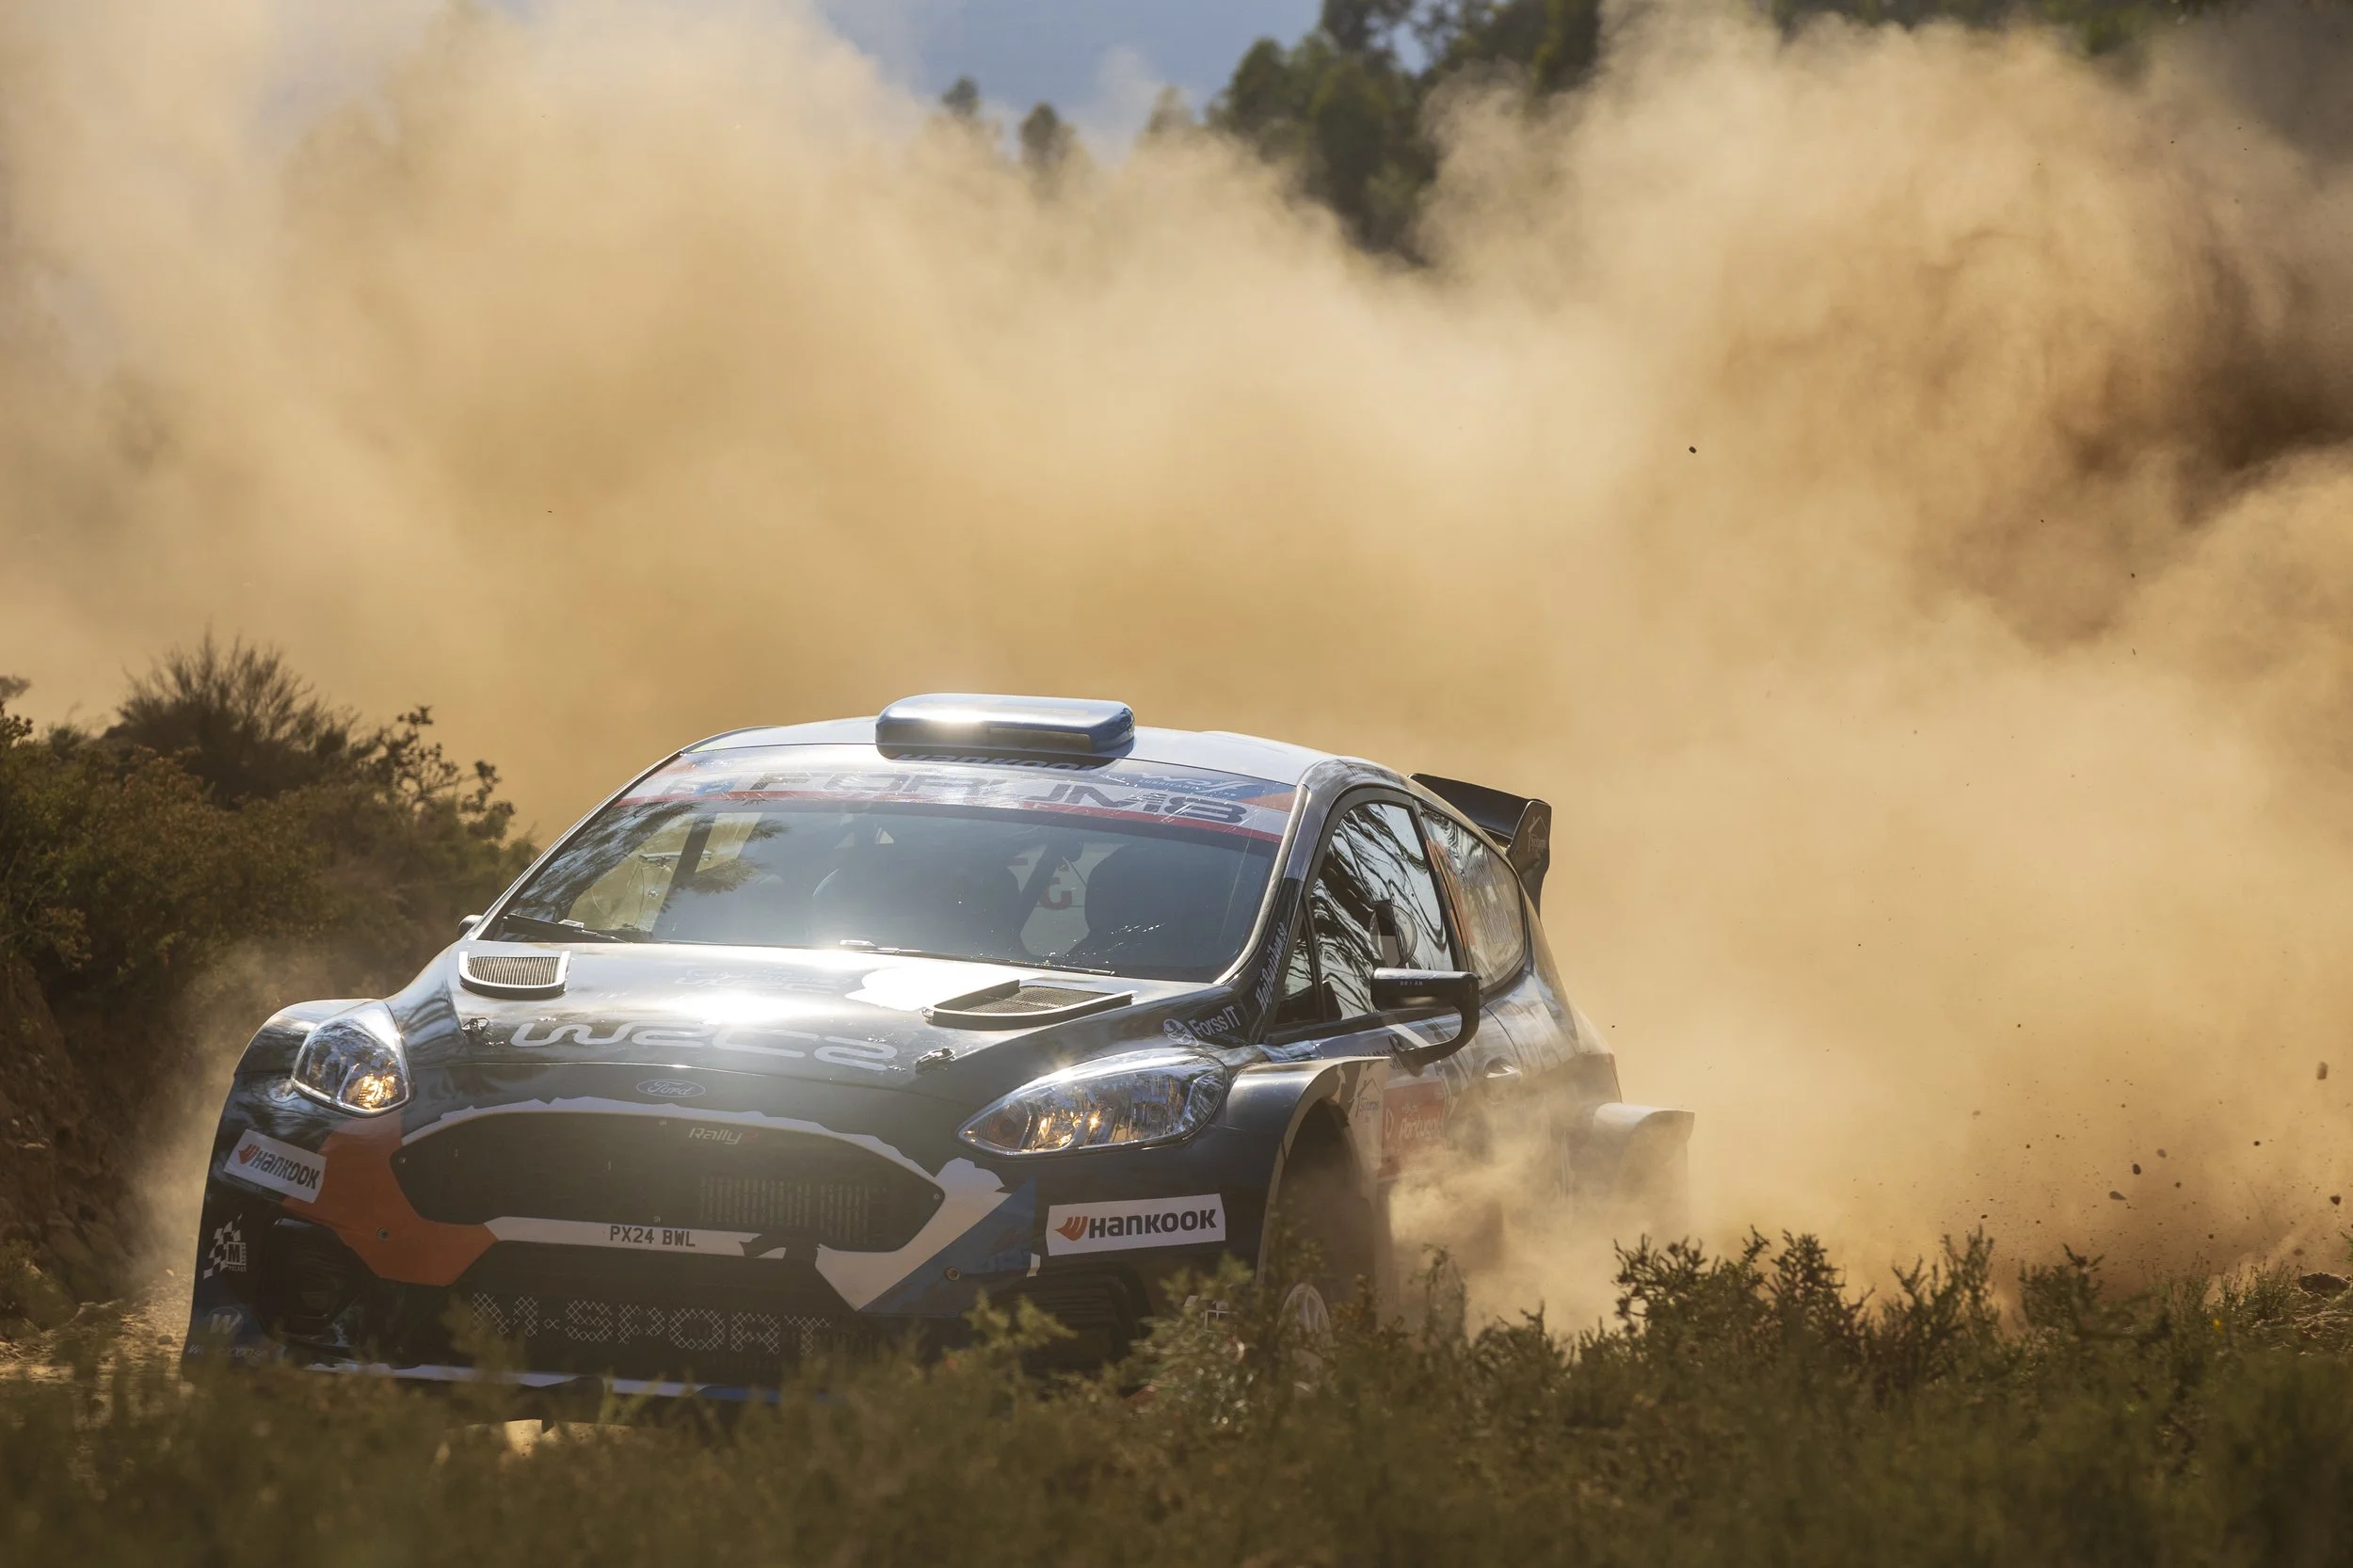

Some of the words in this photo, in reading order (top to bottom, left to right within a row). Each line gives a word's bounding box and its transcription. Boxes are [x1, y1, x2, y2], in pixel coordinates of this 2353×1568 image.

[1189, 1015, 1228, 1037] Forss
[1223, 1005, 1241, 1028] IT
[648, 1081, 693, 1096] Ford
[609, 1225, 654, 1244] PX24
[662, 1229, 696, 1247] BWL
[471, 1292, 832, 1357] M-SPORT
